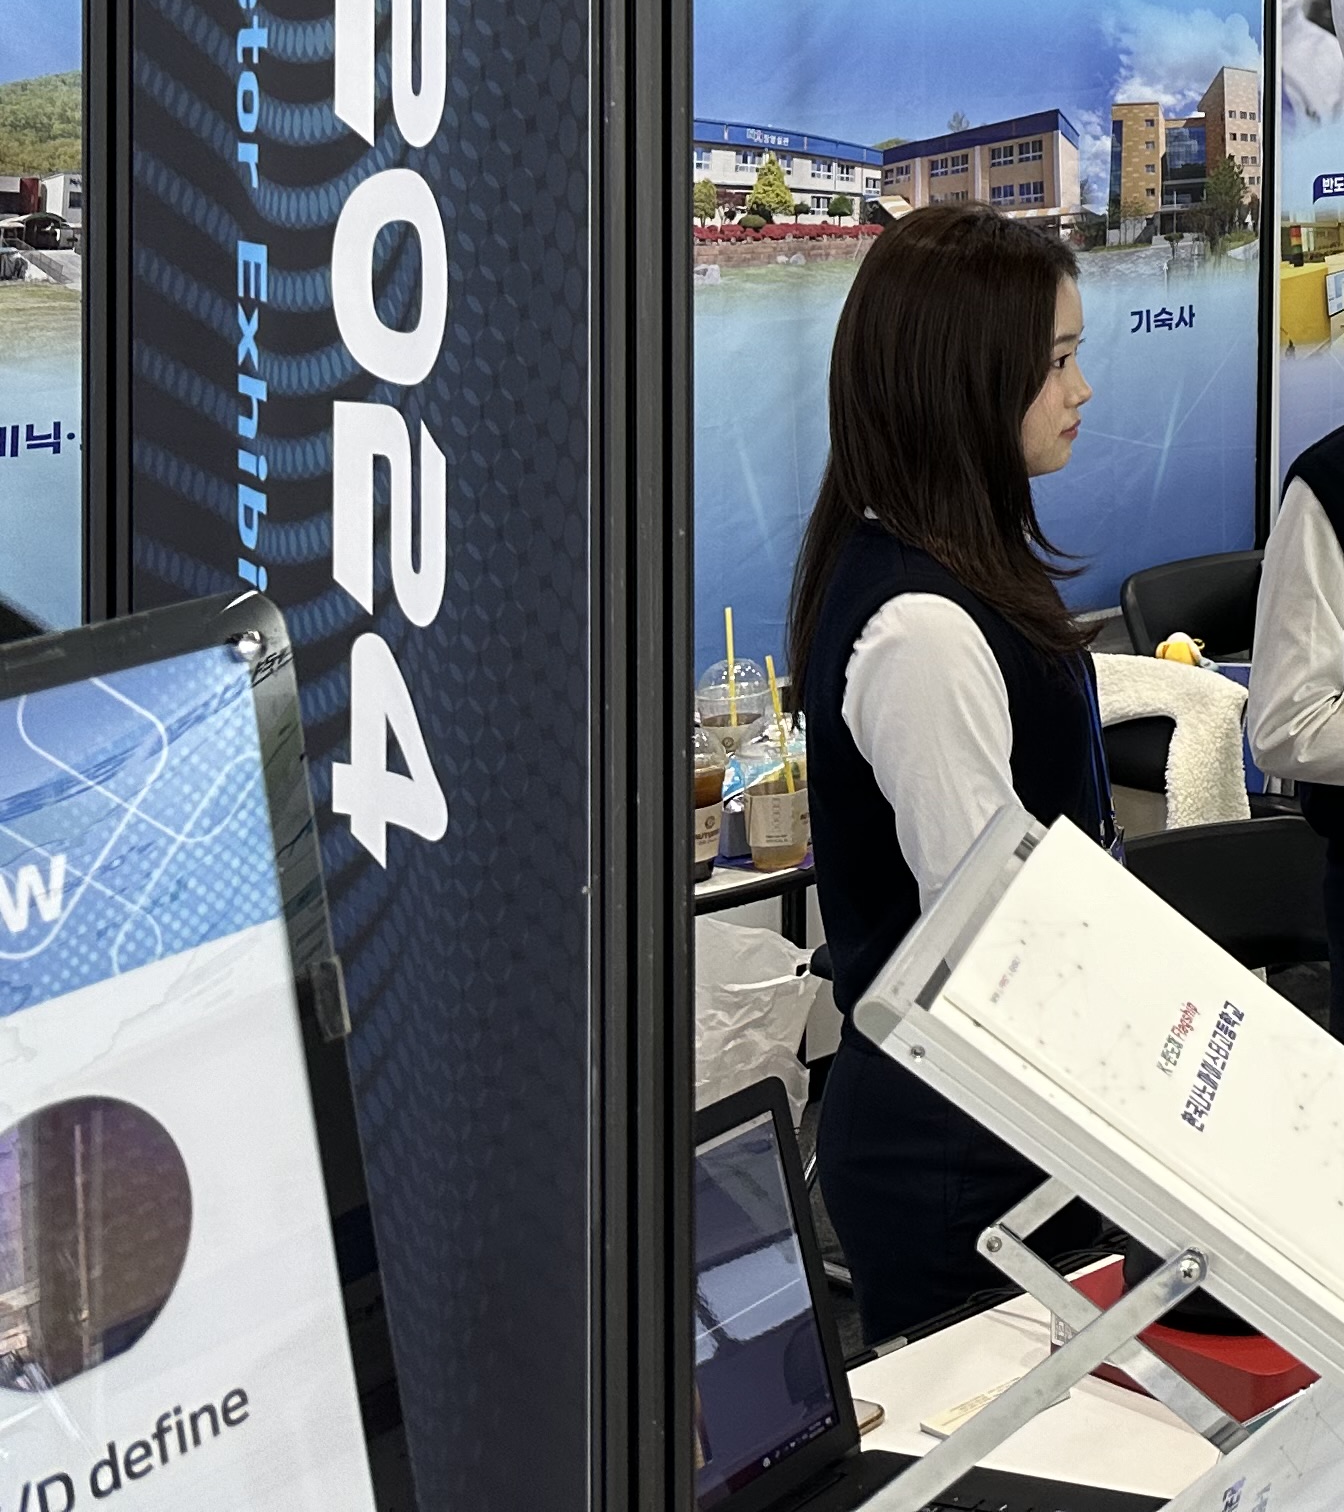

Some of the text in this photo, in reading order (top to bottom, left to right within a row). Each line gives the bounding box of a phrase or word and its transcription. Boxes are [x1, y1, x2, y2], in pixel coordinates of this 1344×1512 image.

[1130, 304, 1195, 334] 기숙사
[236, 239, 269, 592] Exhibi
[1180, 1000, 1245, 1133] 한국나노마이스터고등학교
[90, 1387, 250, 1500] define
